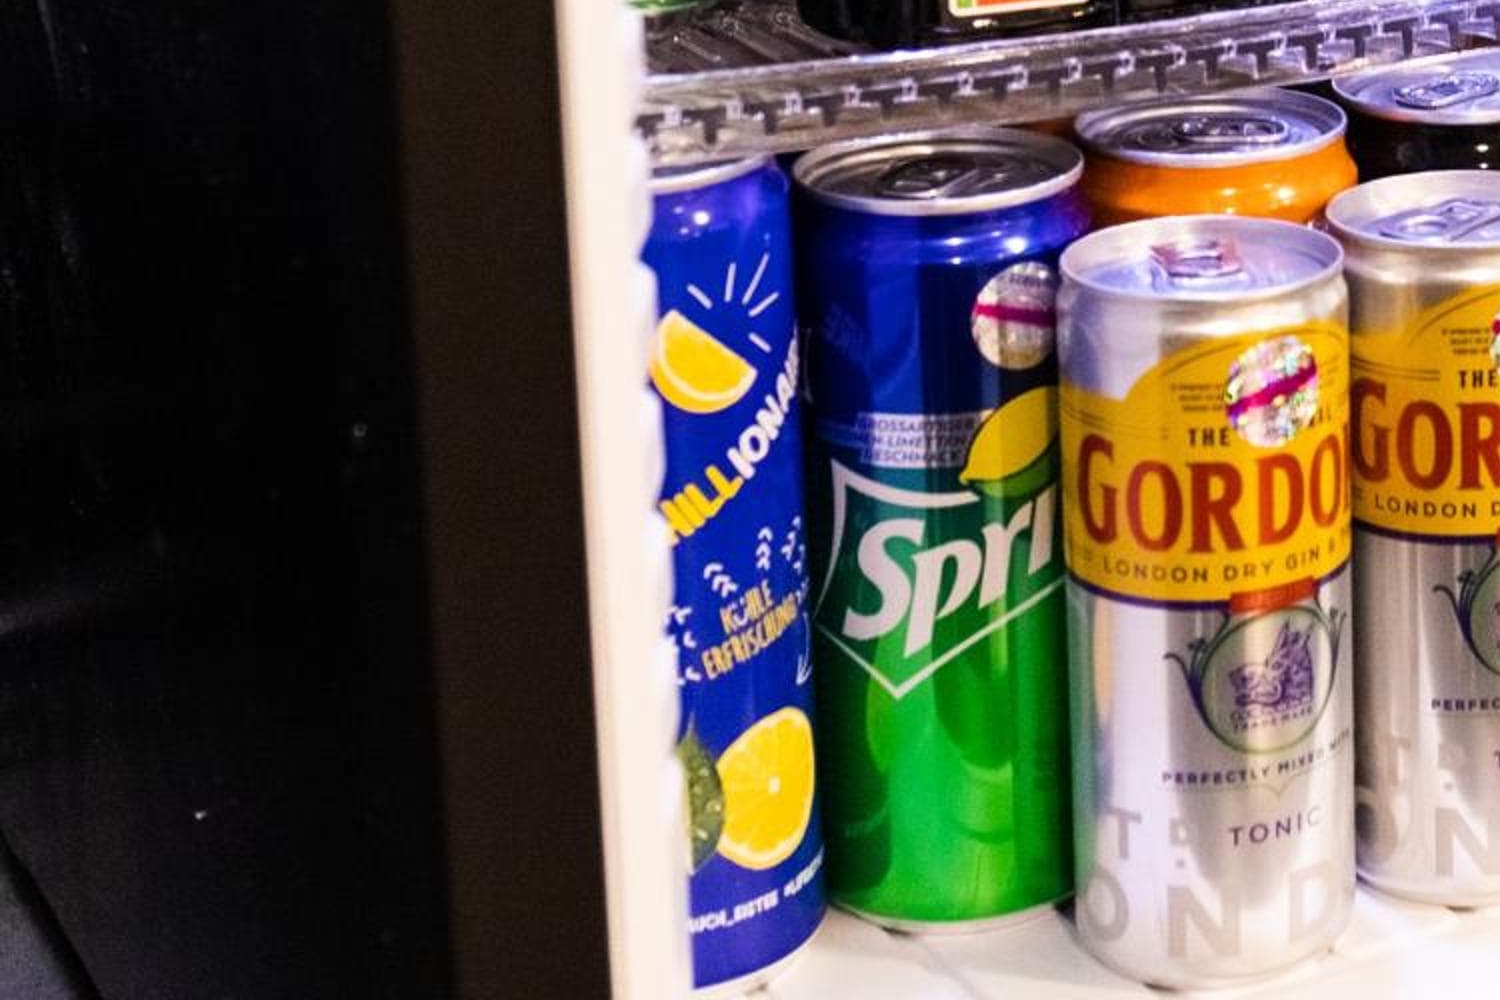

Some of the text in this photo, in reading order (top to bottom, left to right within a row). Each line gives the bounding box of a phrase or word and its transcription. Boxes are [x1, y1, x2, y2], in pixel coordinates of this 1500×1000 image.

[1459, 371, 1498, 389] THE
[1188, 427, 1230, 447] THE
[1077, 430, 1349, 554] GORDO
[1375, 495, 1477, 518] LONDON
[1104, 556, 1208, 583] LONDON
[1223, 562, 1273, 582] DRY
[1286, 544, 1320, 570] GIN
[1162, 766, 1271, 785] PERFECTLY
[1229, 806, 1322, 847] TONIC
